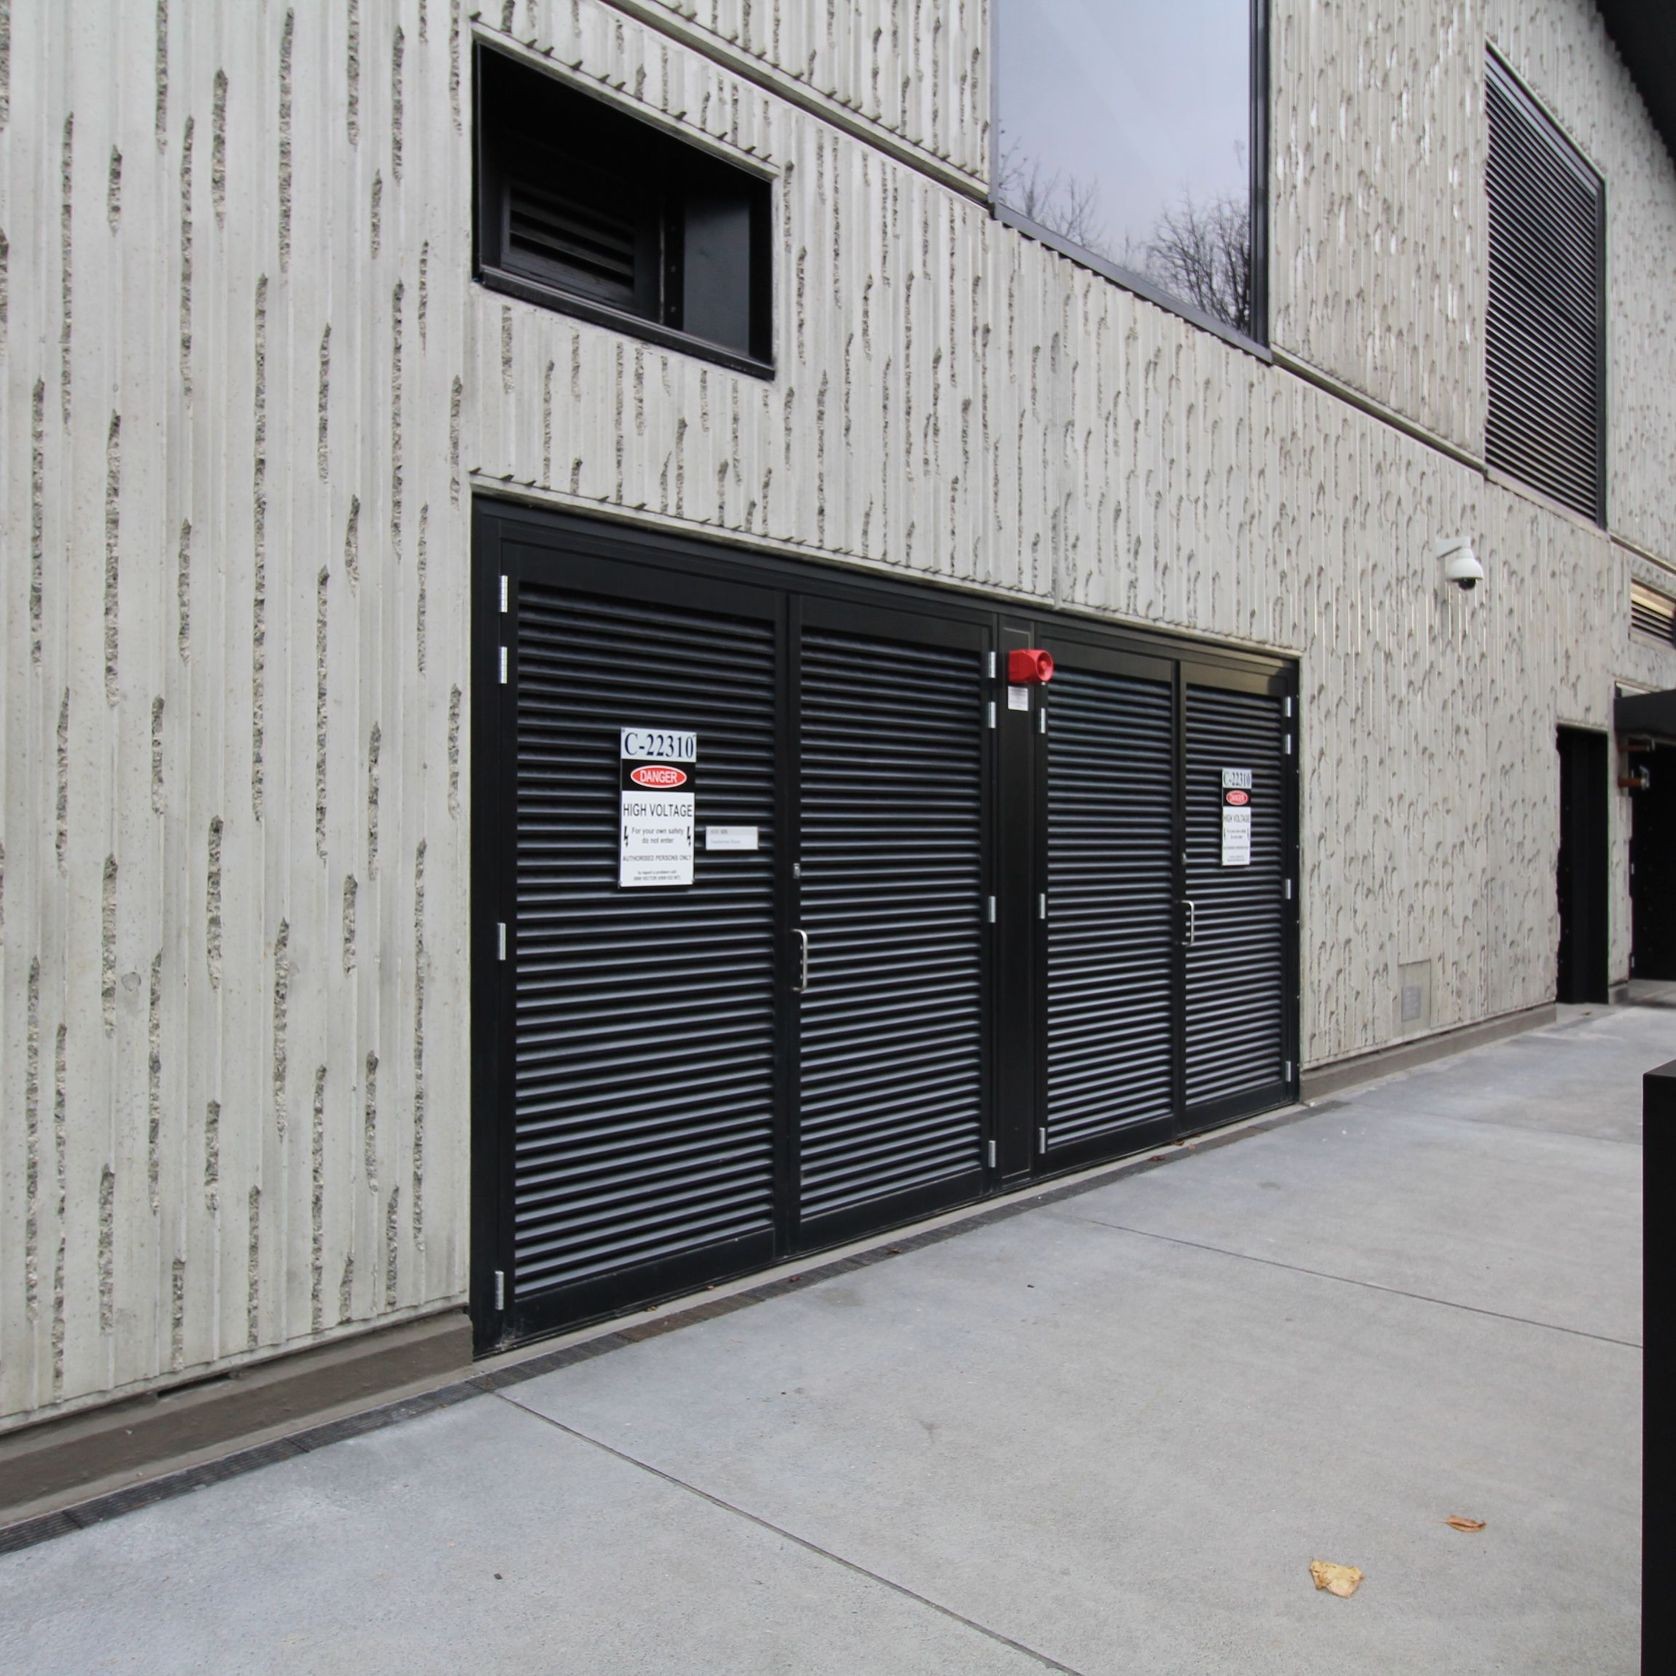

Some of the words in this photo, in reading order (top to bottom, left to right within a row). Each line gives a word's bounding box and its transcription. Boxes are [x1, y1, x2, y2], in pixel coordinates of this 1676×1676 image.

[624, 732, 694, 758] C-22310
[640, 770, 678, 783] DANGER
[623, 803, 647, 816] HIGH
[649, 803, 693, 817] VOLTAGE
[642, 828, 654, 836] your
[668, 827, 684, 836] safety
